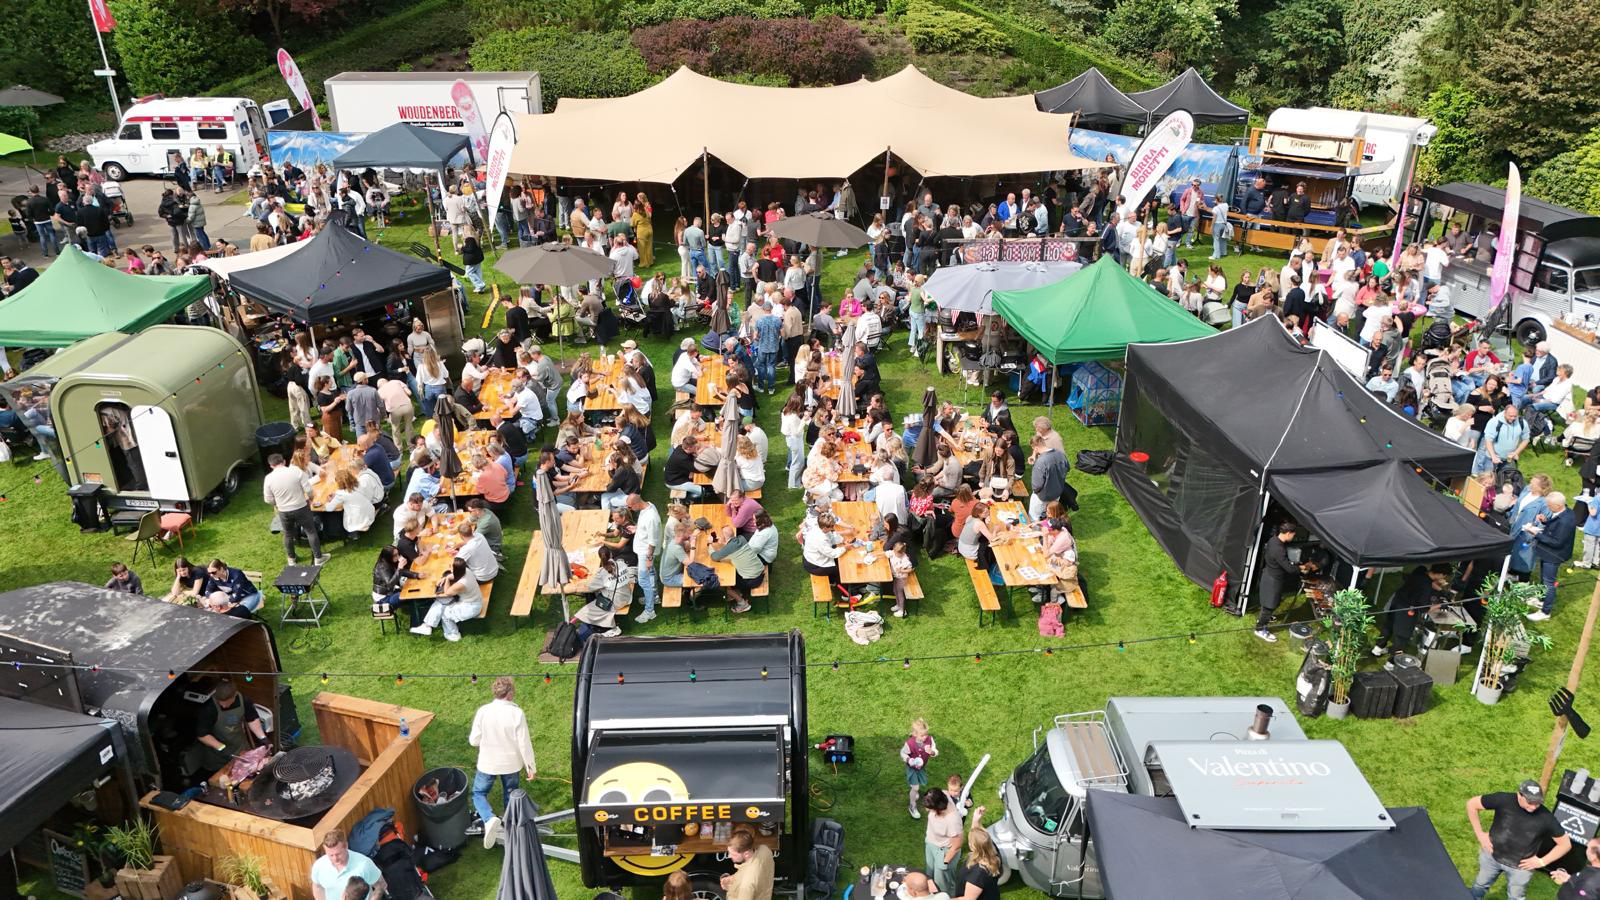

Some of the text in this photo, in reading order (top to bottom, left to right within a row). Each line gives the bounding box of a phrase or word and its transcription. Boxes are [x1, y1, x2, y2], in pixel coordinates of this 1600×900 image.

[1130, 148, 1157, 180] BIRRA
[1131, 146, 1169, 191] MORETTI
[1187, 755, 1331, 777] Valentino
[634, 804, 732, 822] COFFEE
